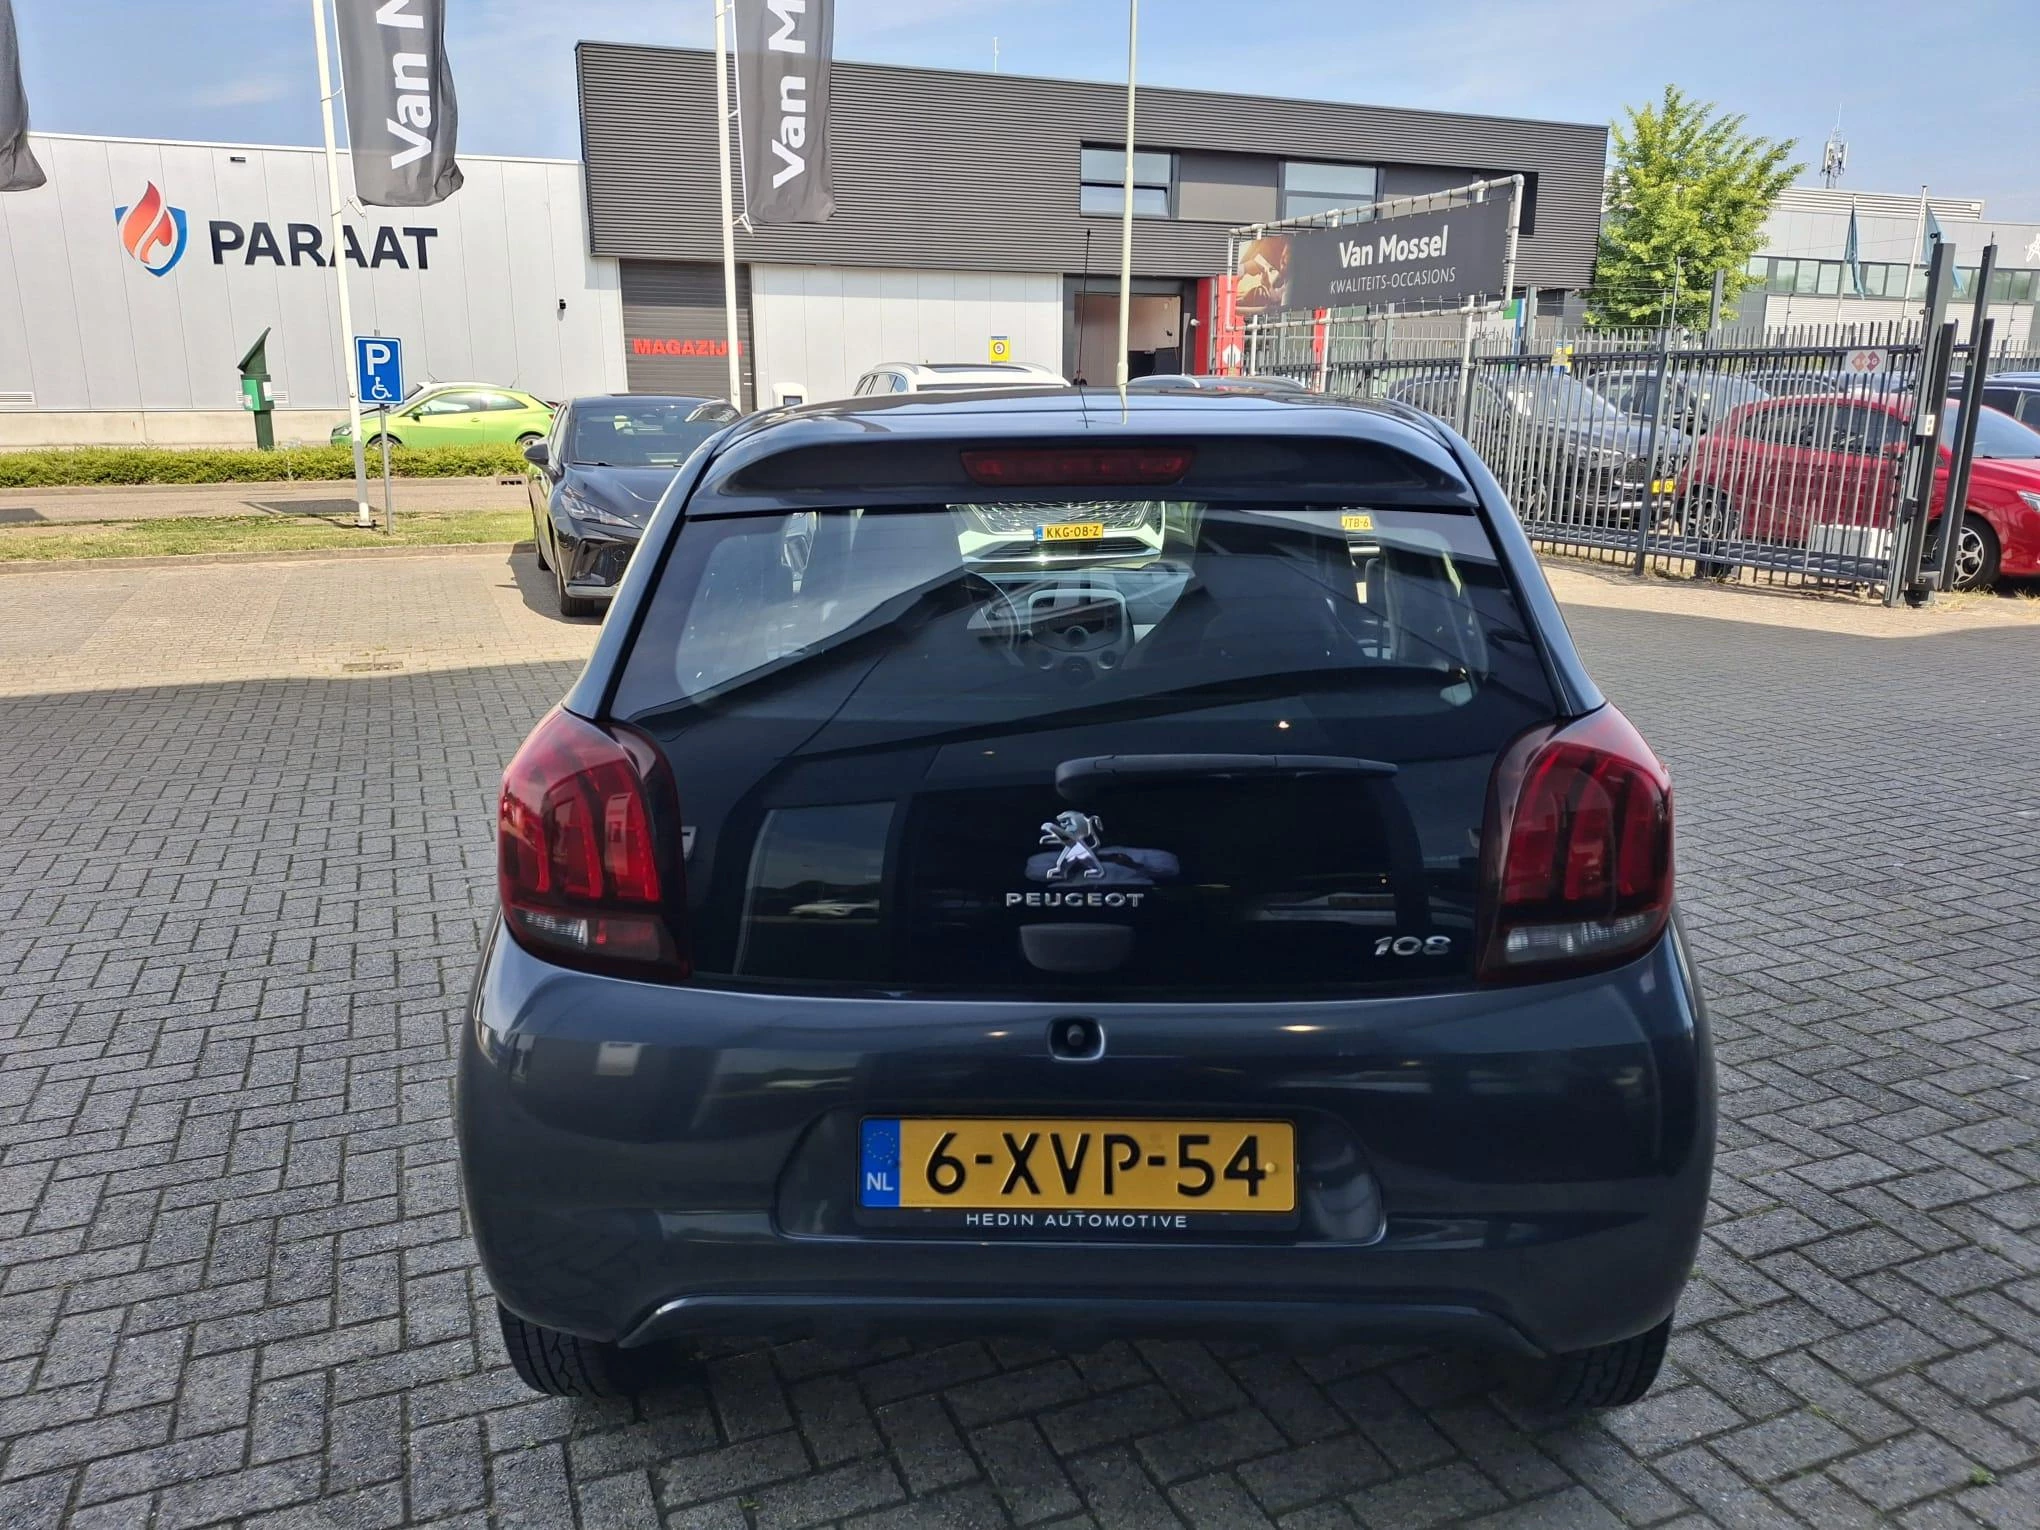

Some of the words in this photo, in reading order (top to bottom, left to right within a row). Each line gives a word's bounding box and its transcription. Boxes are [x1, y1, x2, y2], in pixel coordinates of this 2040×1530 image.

[386, 52, 432, 170] Van
[771, 75, 806, 190] Van
[208, 220, 439, 270] PARAAT
[1339, 240, 1374, 269] Van
[1378, 224, 1449, 265] Mossel
[1330, 266, 1457, 295] KWALITEITS-OCCASIONS
[365, 343, 391, 376] P
[1005, 892, 1144, 908] PEUGEOT
[1374, 935, 1452, 956] 108
[865, 1172, 894, 1191] NL
[925, 1132, 1268, 1197] 6-XVP-54
[966, 1213, 1034, 1226] HEDIN
[1044, 1214, 1188, 1228] AUTOMOTIVE
